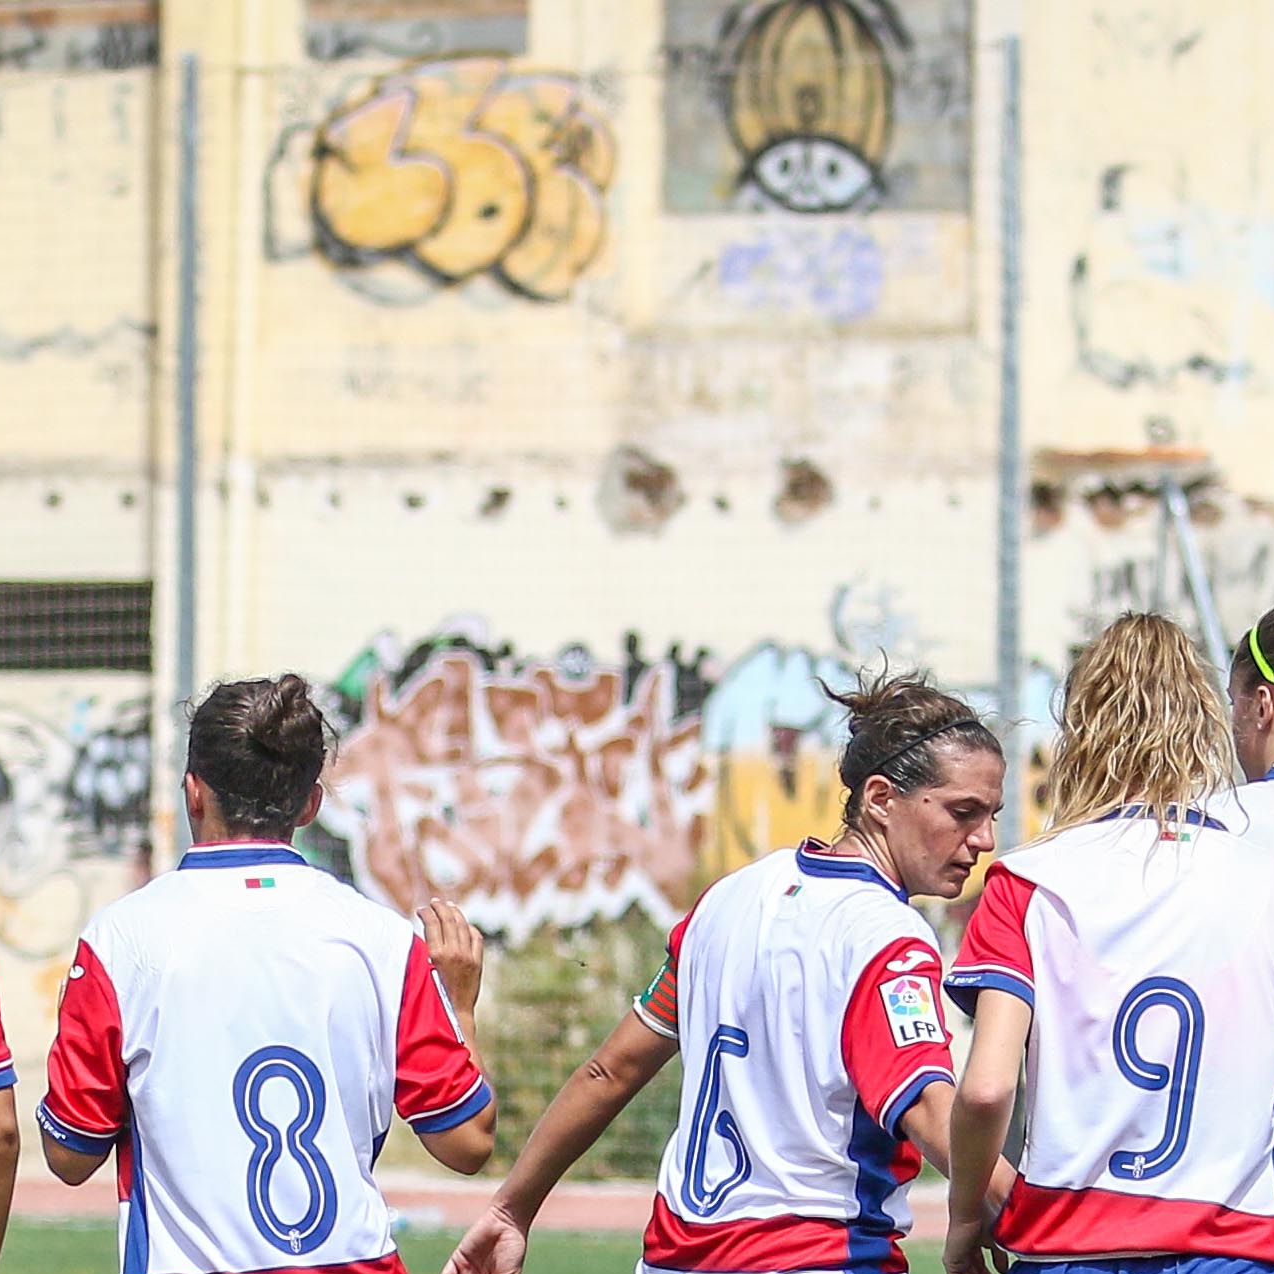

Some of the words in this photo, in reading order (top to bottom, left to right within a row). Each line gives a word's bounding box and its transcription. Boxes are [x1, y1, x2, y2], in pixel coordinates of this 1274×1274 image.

[680, 1023, 752, 1218] 6
[899, 1020, 937, 1042] LFP
[1108, 975, 1206, 1181] 9
[232, 1044, 339, 1256] 8
